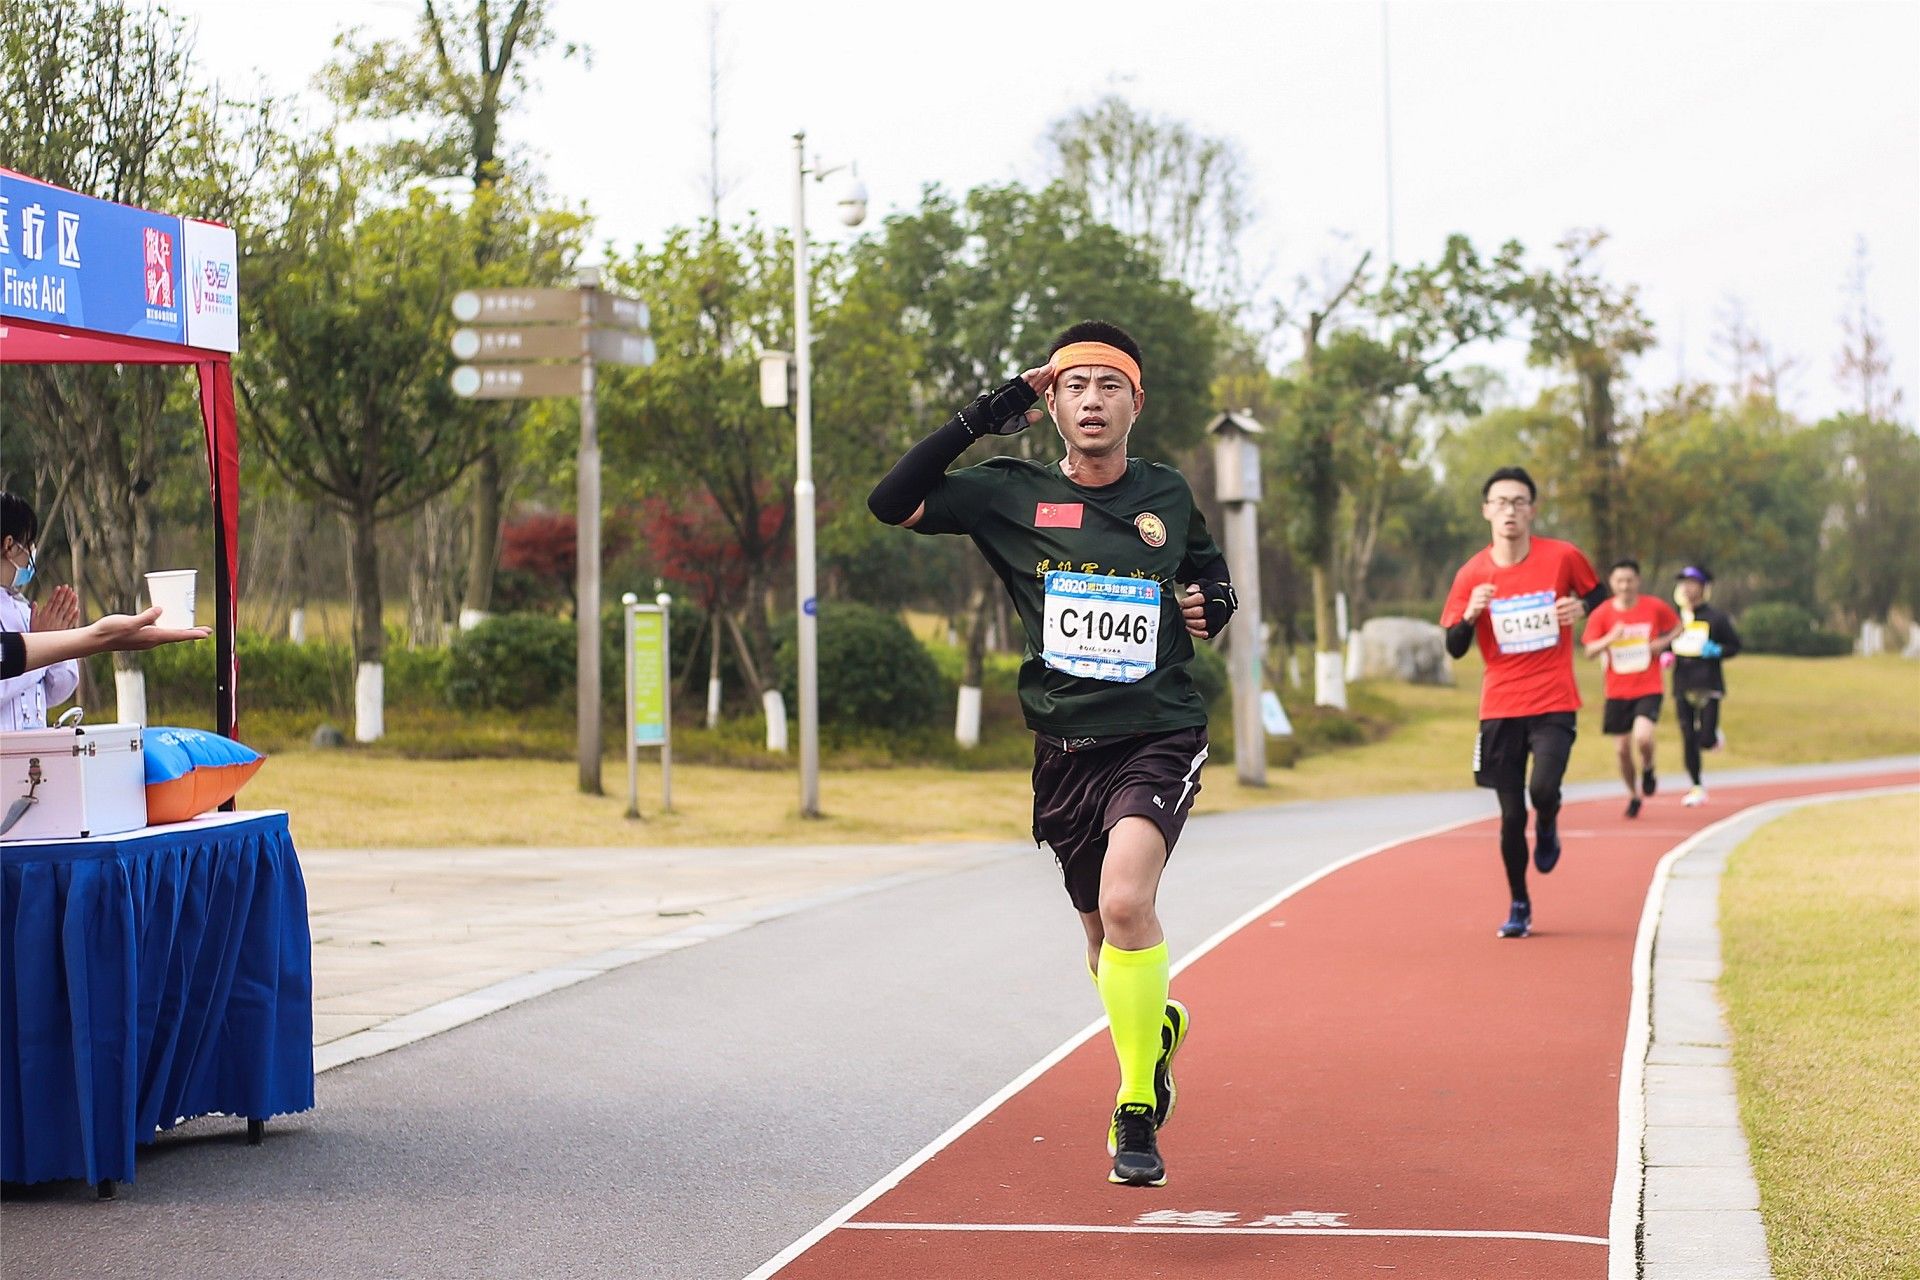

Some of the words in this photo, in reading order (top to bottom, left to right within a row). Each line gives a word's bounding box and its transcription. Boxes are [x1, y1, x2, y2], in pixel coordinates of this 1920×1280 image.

[4, 266, 38, 310] First
[41, 274, 65, 315] Aid
[1060, 608, 1148, 645] C1046
[1502, 613, 1551, 634] C1424
